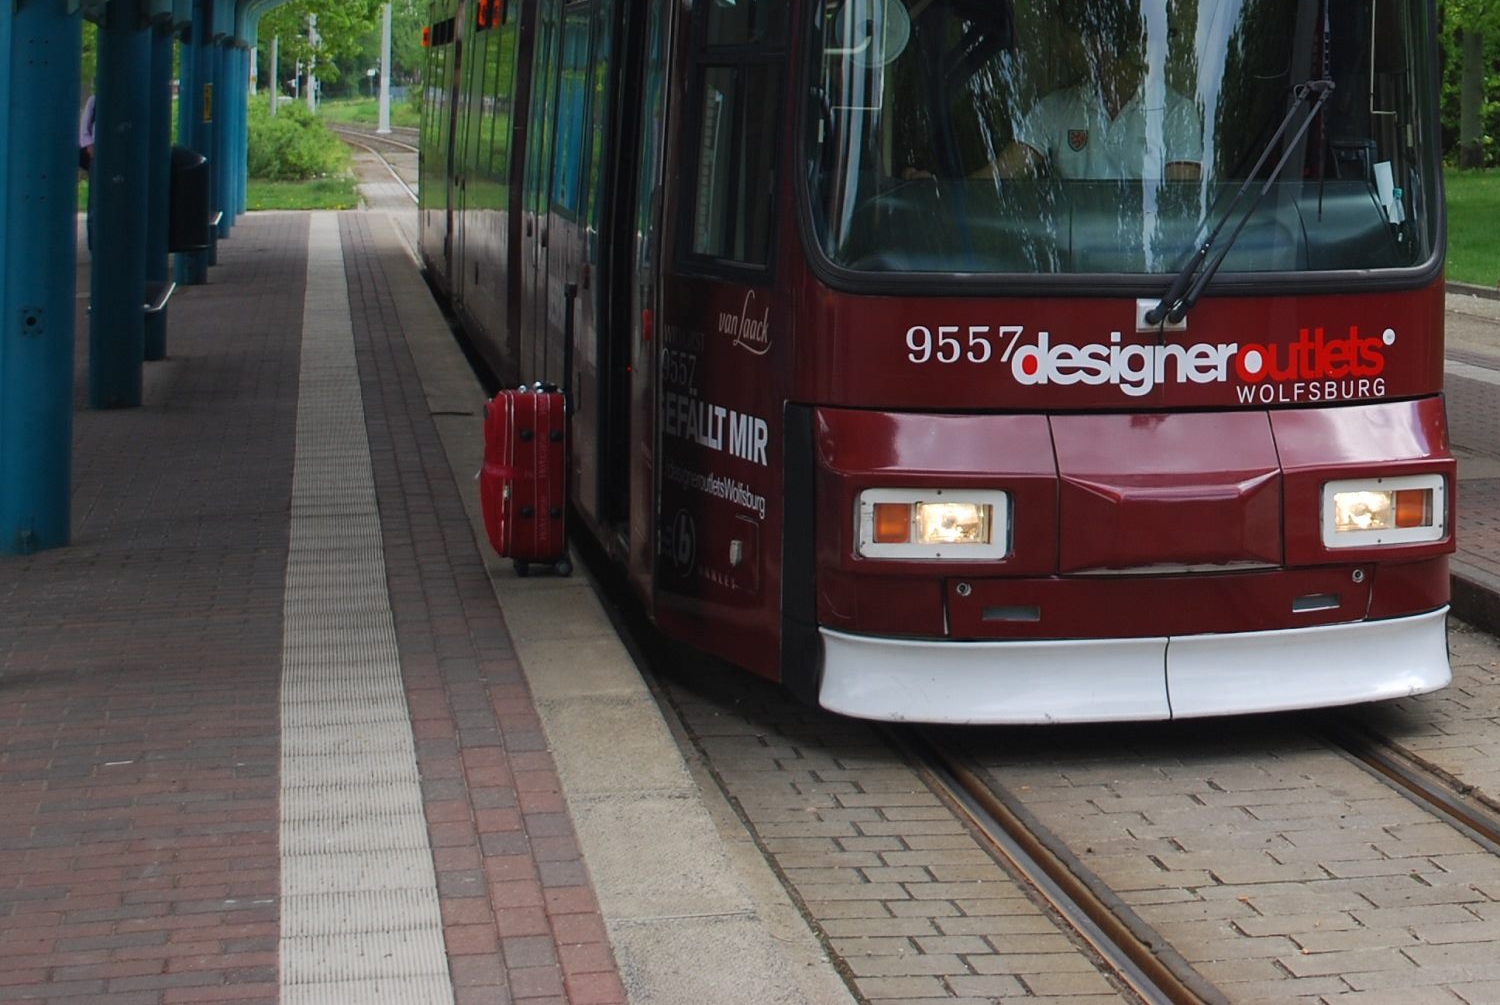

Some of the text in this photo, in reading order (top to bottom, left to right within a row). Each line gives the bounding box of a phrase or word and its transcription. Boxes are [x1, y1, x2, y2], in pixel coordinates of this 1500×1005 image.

[906, 325, 1024, 365] 9557
[1236, 379, 1386, 404] WOLFSBURG
[729, 410, 768, 467] MIR
